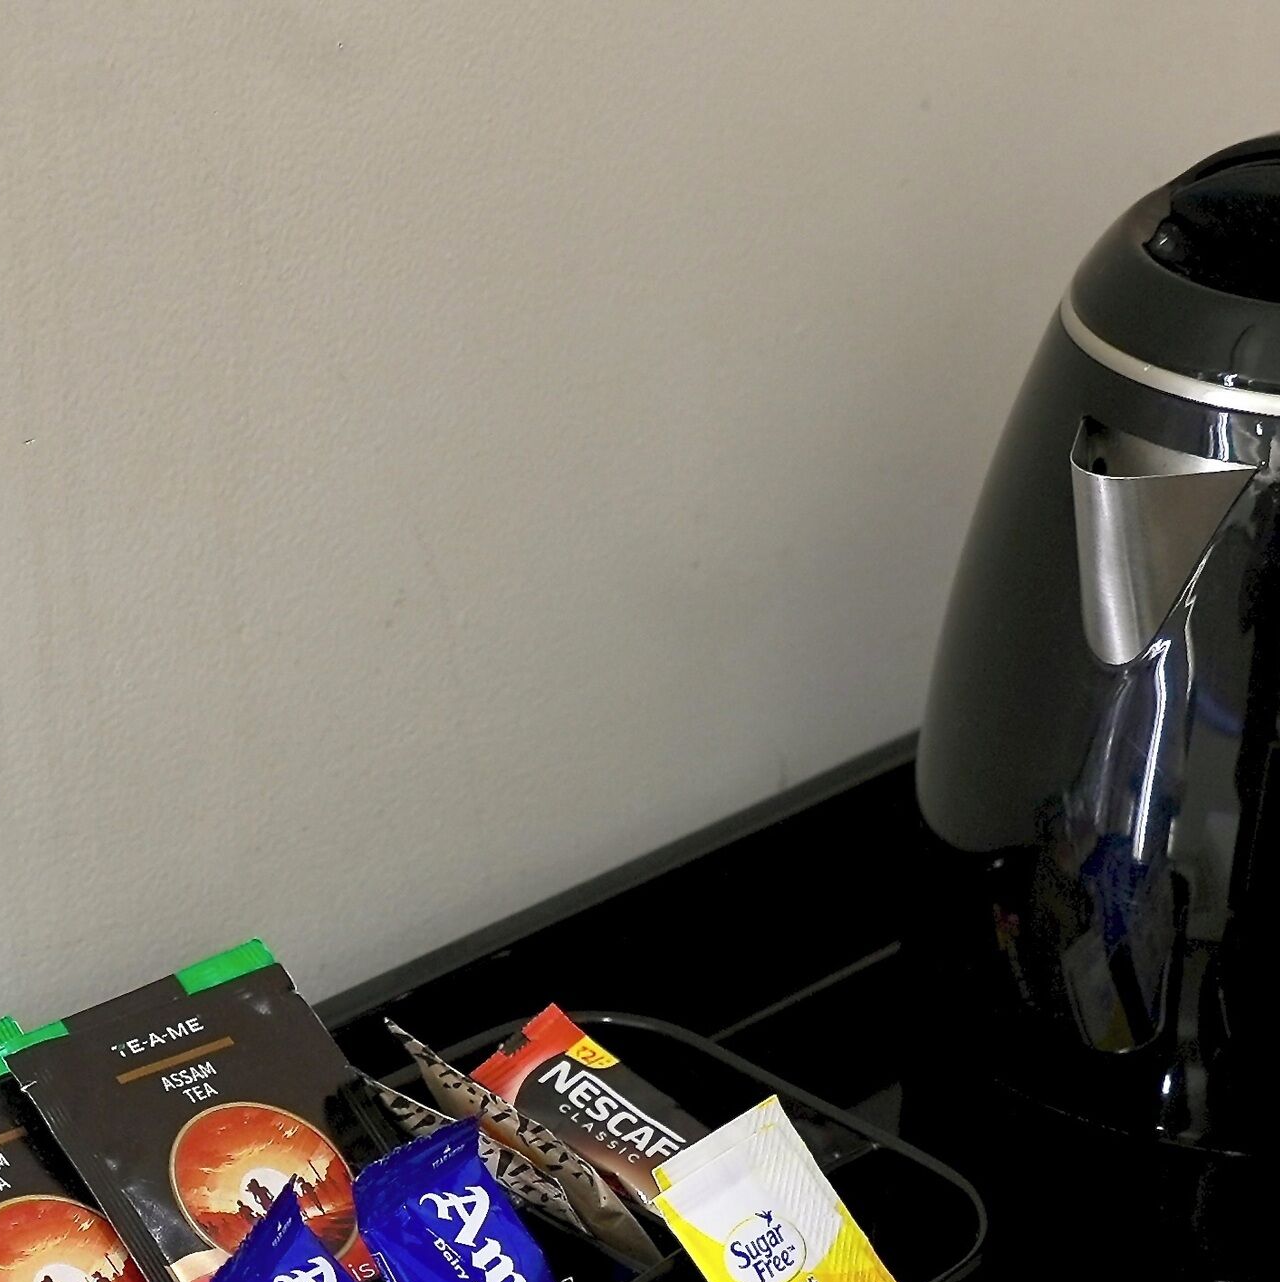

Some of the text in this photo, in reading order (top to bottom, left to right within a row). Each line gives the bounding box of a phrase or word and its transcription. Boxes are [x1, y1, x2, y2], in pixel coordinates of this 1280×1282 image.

[110, 1017, 204, 1058] TE-A-ME
[161, 1061, 218, 1092] ASSAM
[182, 1082, 219, 1104] TEA
[558, 1103, 640, 1164] CLASSIC
[433, 1237, 469, 1279] Dairy
[730, 1223, 784, 1269] Sugar
